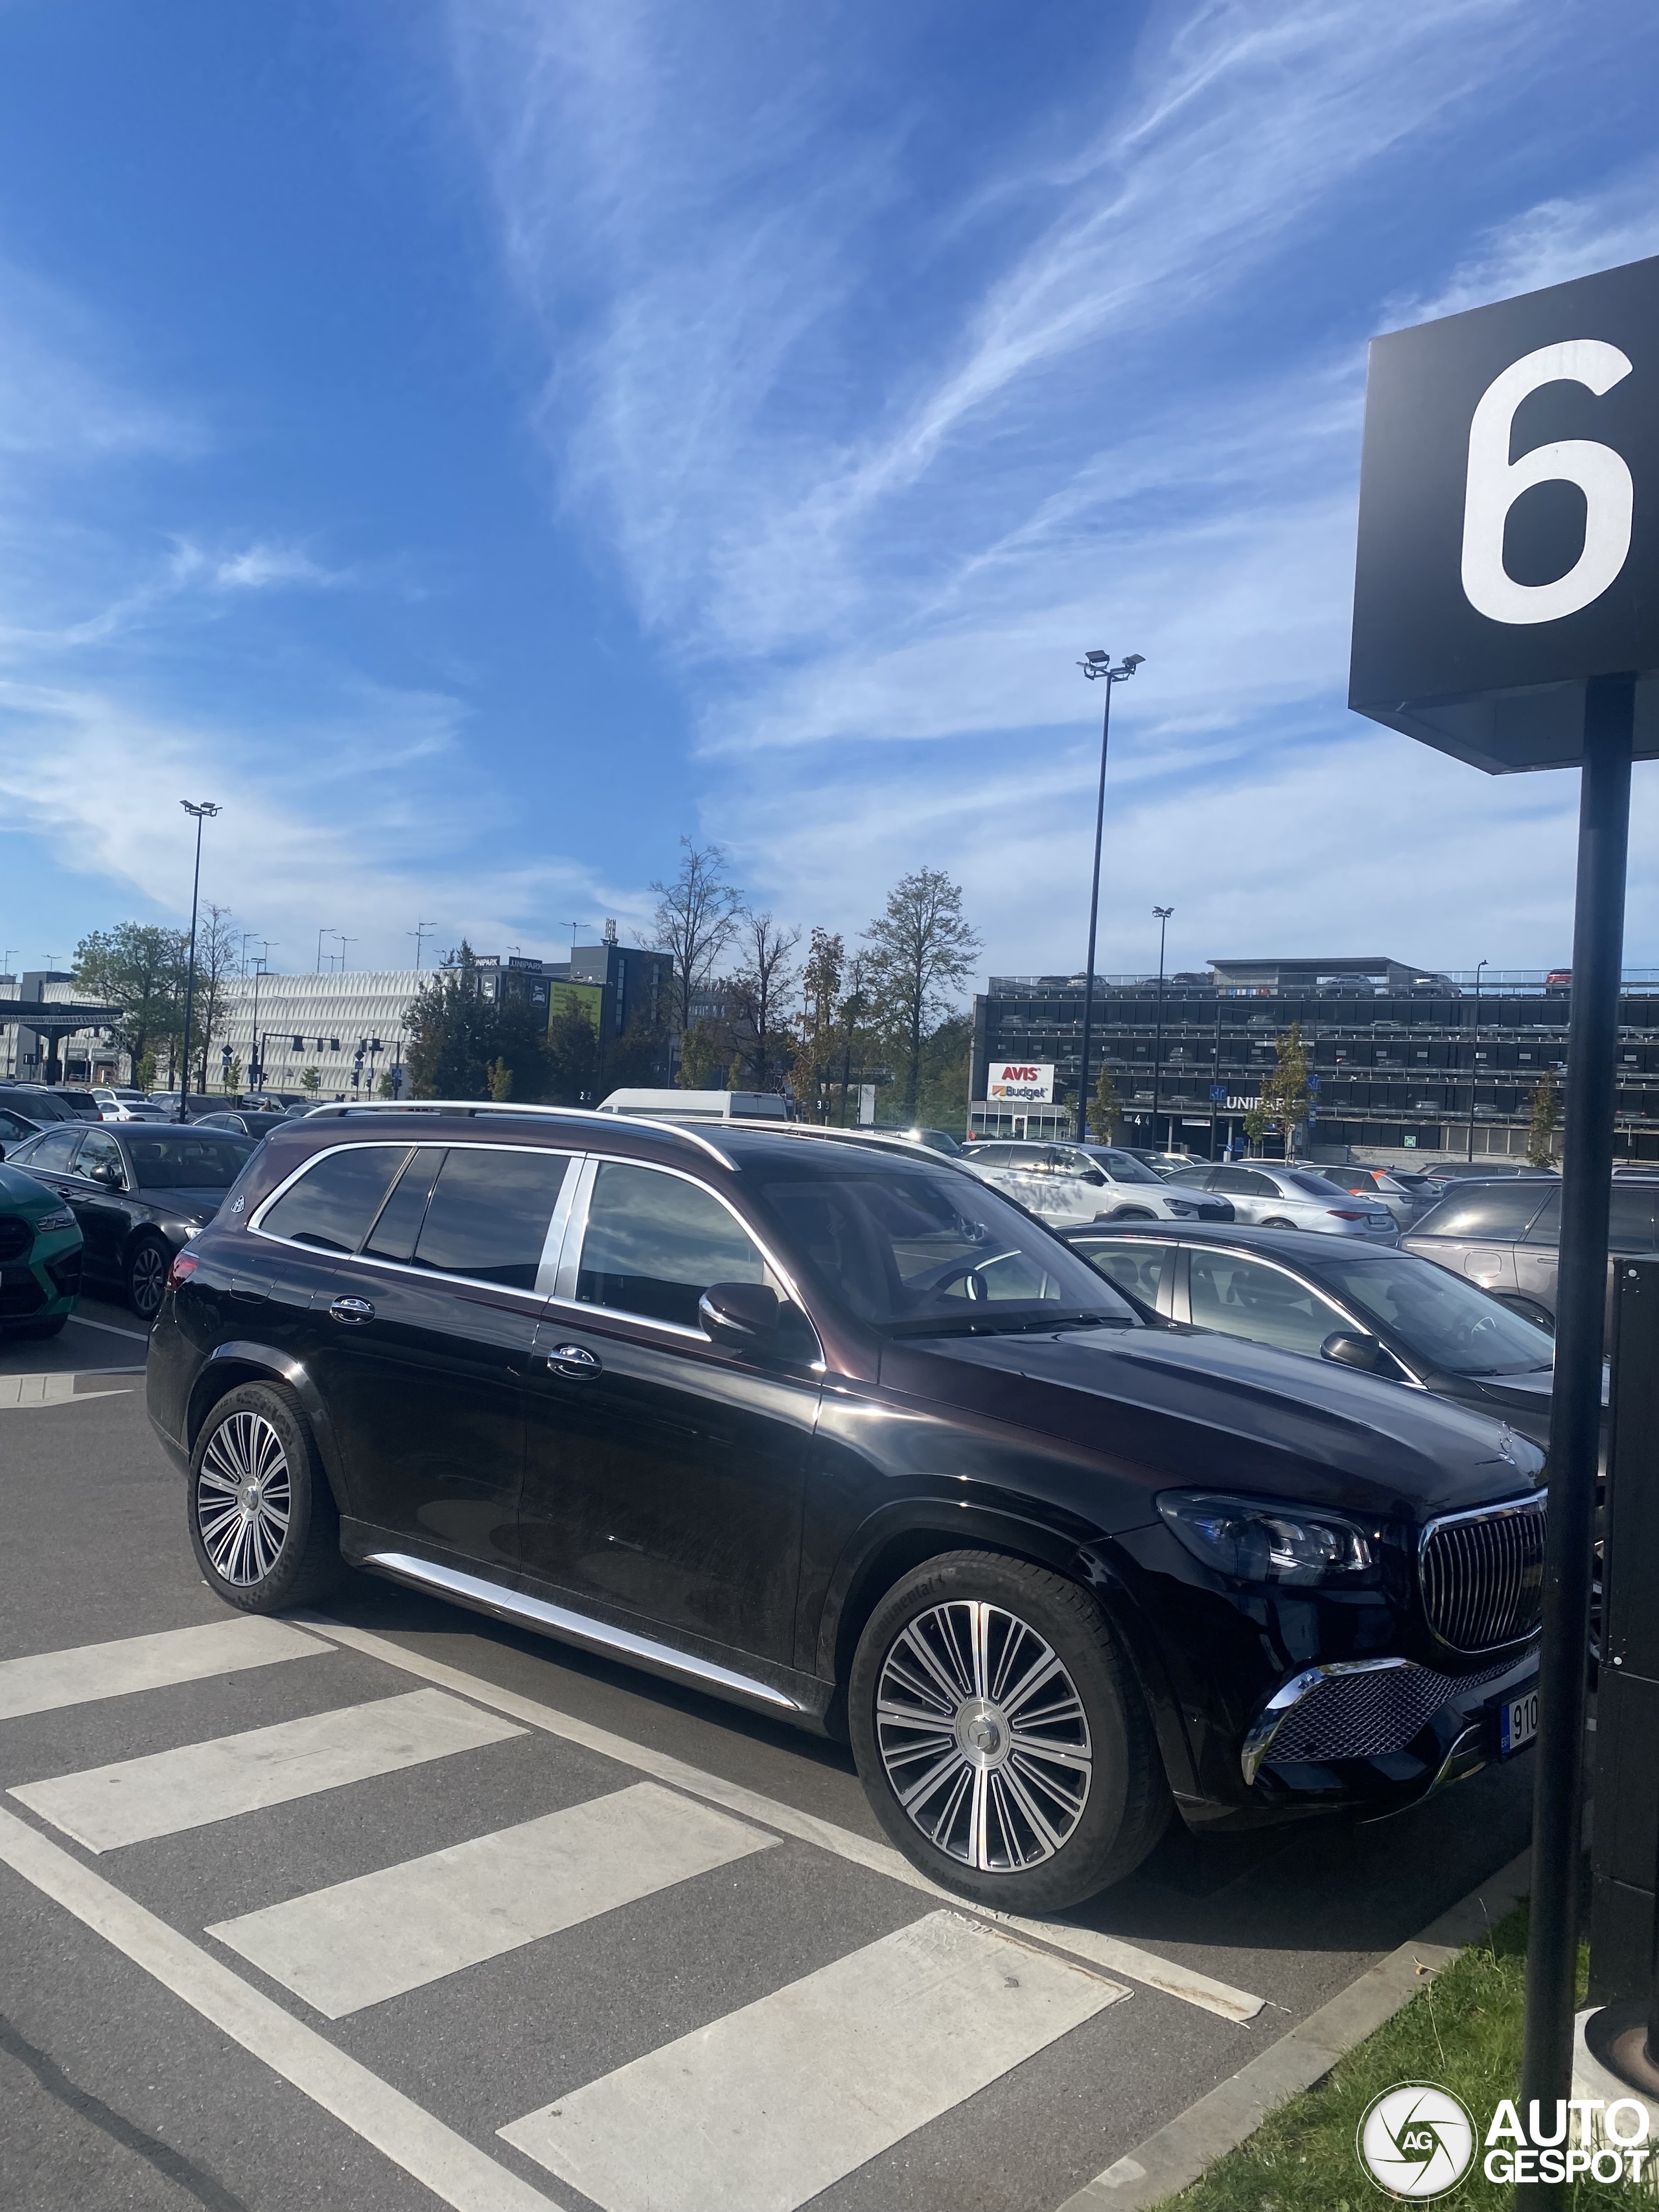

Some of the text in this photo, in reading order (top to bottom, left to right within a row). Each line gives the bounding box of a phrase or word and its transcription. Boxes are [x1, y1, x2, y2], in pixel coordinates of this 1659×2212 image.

[1461, 338, 1634, 625] 6
[1001, 1067, 1038, 1081] AVIS
[580, 1091, 584, 1100] 2
[1006, 1086, 1045, 1101] Budget
[817, 1100, 821, 1109] 3
[1134, 1115, 1141, 1125] 4
